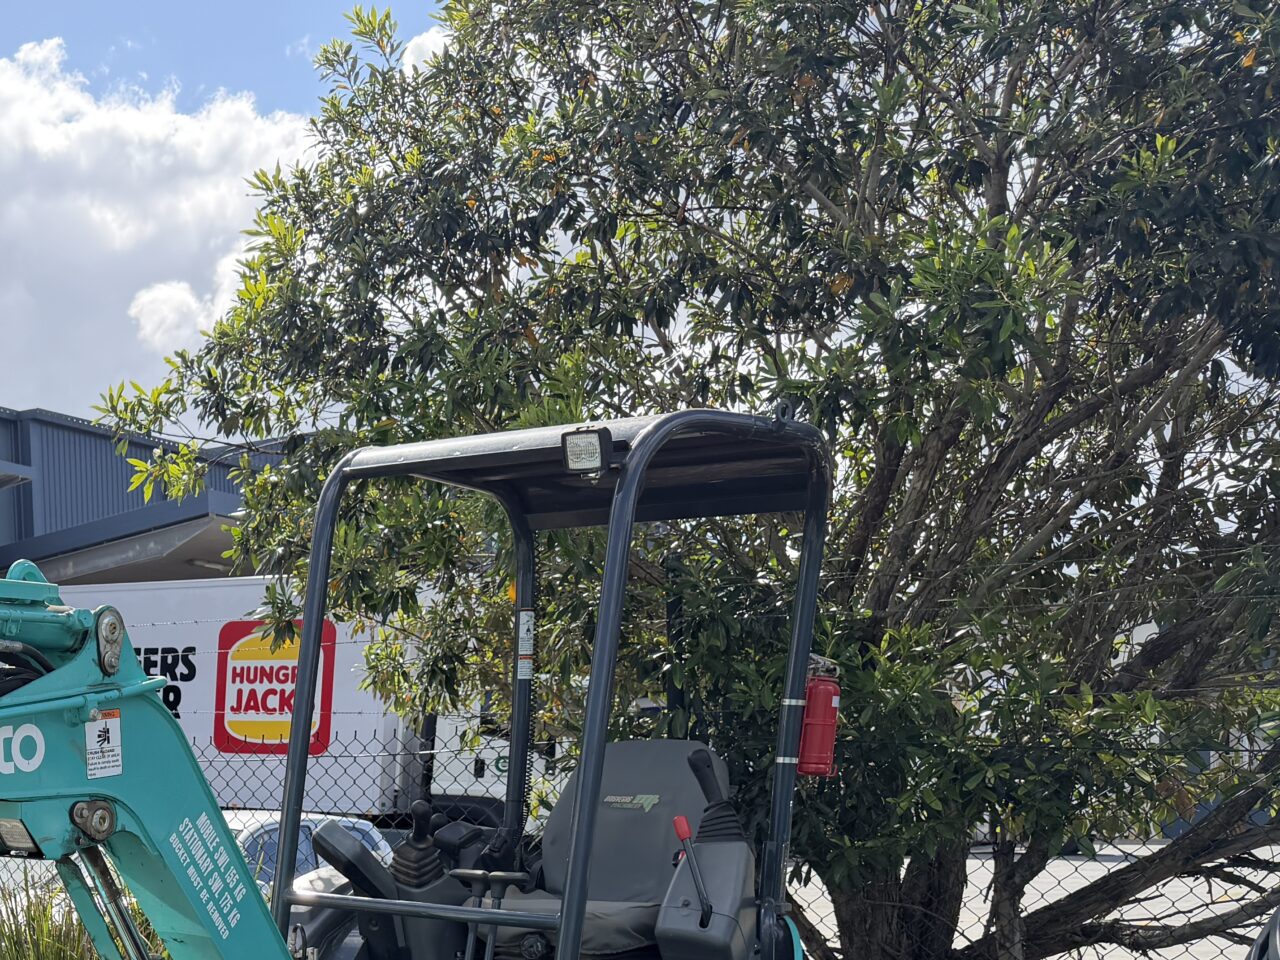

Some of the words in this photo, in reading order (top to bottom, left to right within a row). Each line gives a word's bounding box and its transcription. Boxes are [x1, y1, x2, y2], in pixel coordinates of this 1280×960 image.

[169, 832, 191, 867] BUCKET
[186, 864, 203, 891] MUST
[199, 888, 210, 904] BE
[206, 900, 230, 940] REMOVED
[178, 817, 215, 877] STATIONARY
[208, 871, 224, 898] SWL
[218, 891, 234, 914] 175
[227, 907, 241, 928] KG
[195, 811, 220, 852] MOBILE
[214, 845, 230, 873] SWL
[224, 865, 240, 889] 155
[233, 882, 247, 903] KG
